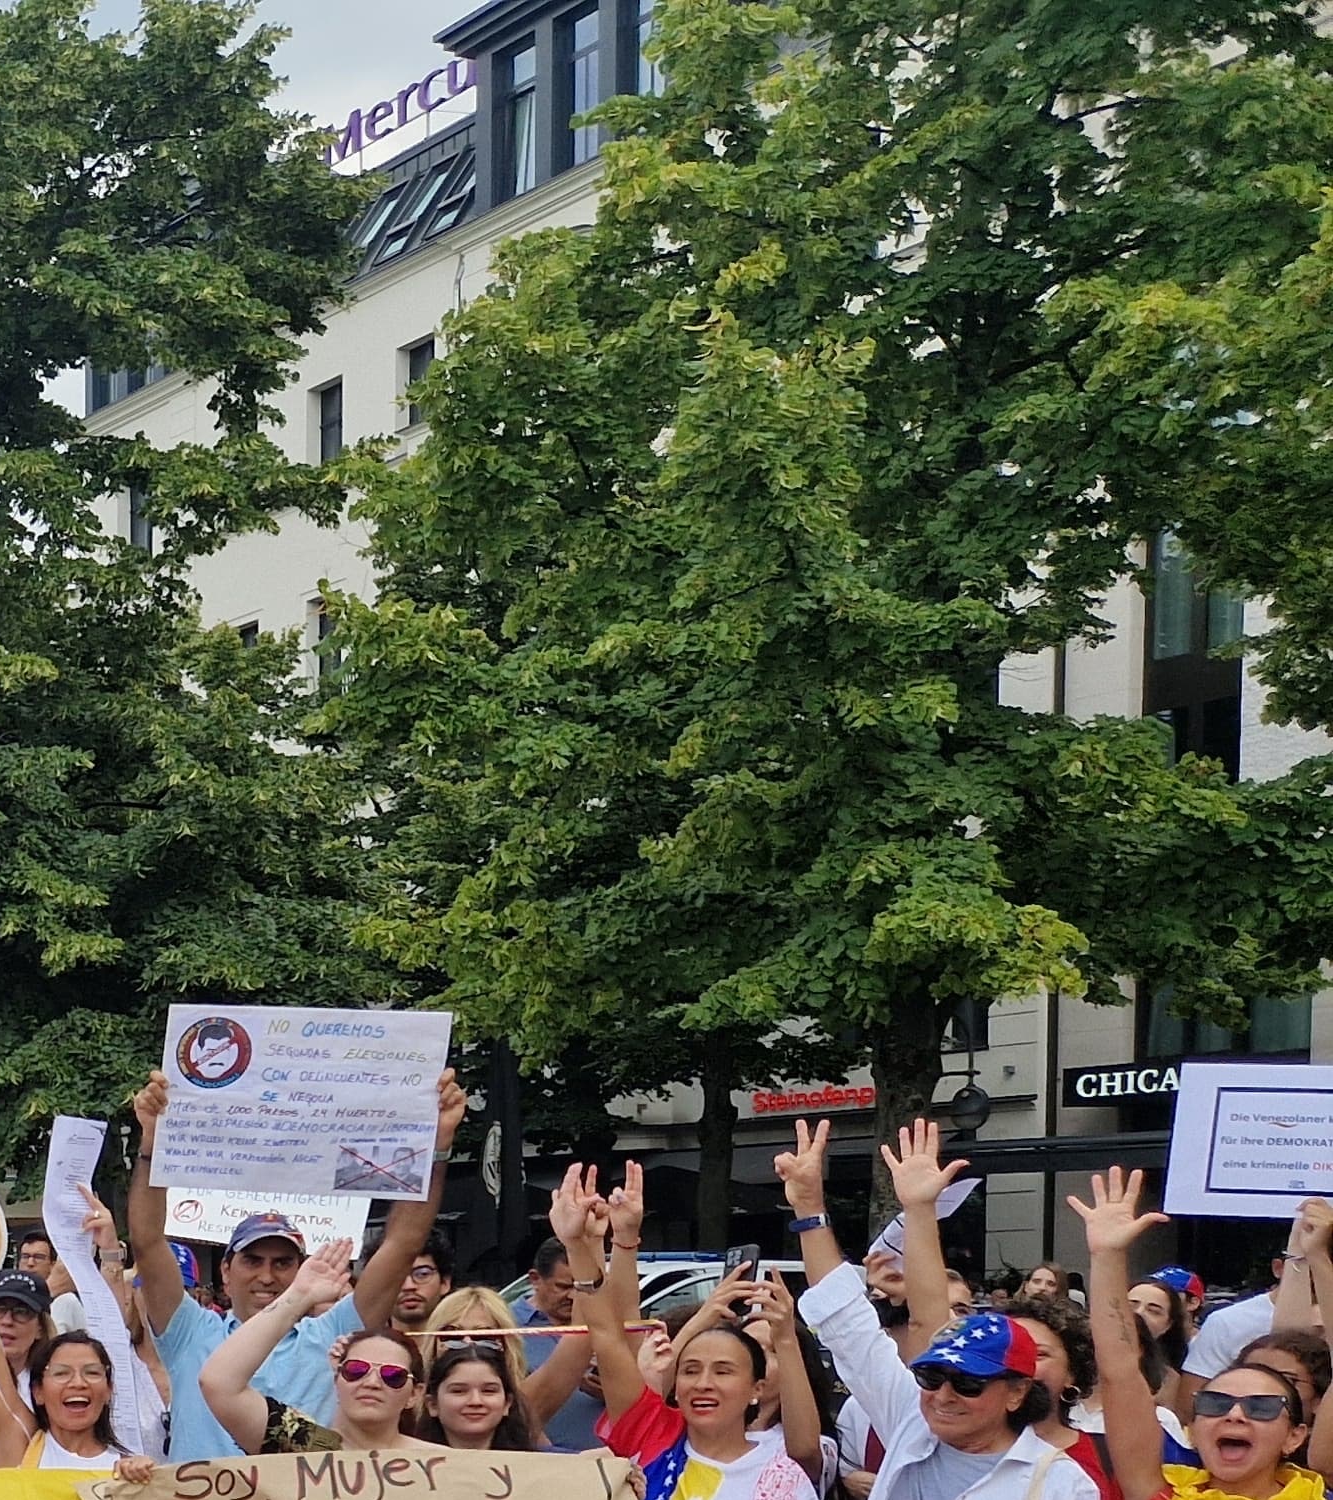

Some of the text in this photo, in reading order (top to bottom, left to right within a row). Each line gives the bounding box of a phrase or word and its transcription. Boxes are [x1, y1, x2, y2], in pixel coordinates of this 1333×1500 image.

[325, 58, 478, 167] Mercu
[268, 1019, 387, 1039] NO QUEREMOS
[260, 1067, 290, 1083] CON
[399, 1072, 424, 1086] NO
[1075, 1067, 1180, 1098] CHICA
[259, 1090, 280, 1103] SE
[1230, 1113, 1326, 1124] Die Venezolaner
[1240, 1136, 1265, 1146] ihre
[1222, 1160, 1248, 1169] eine
[1250, 1160, 1310, 1171] kriminelle
[269, 1208, 338, 1230] DTATUR,
[485, 1464, 515, 1500] y
